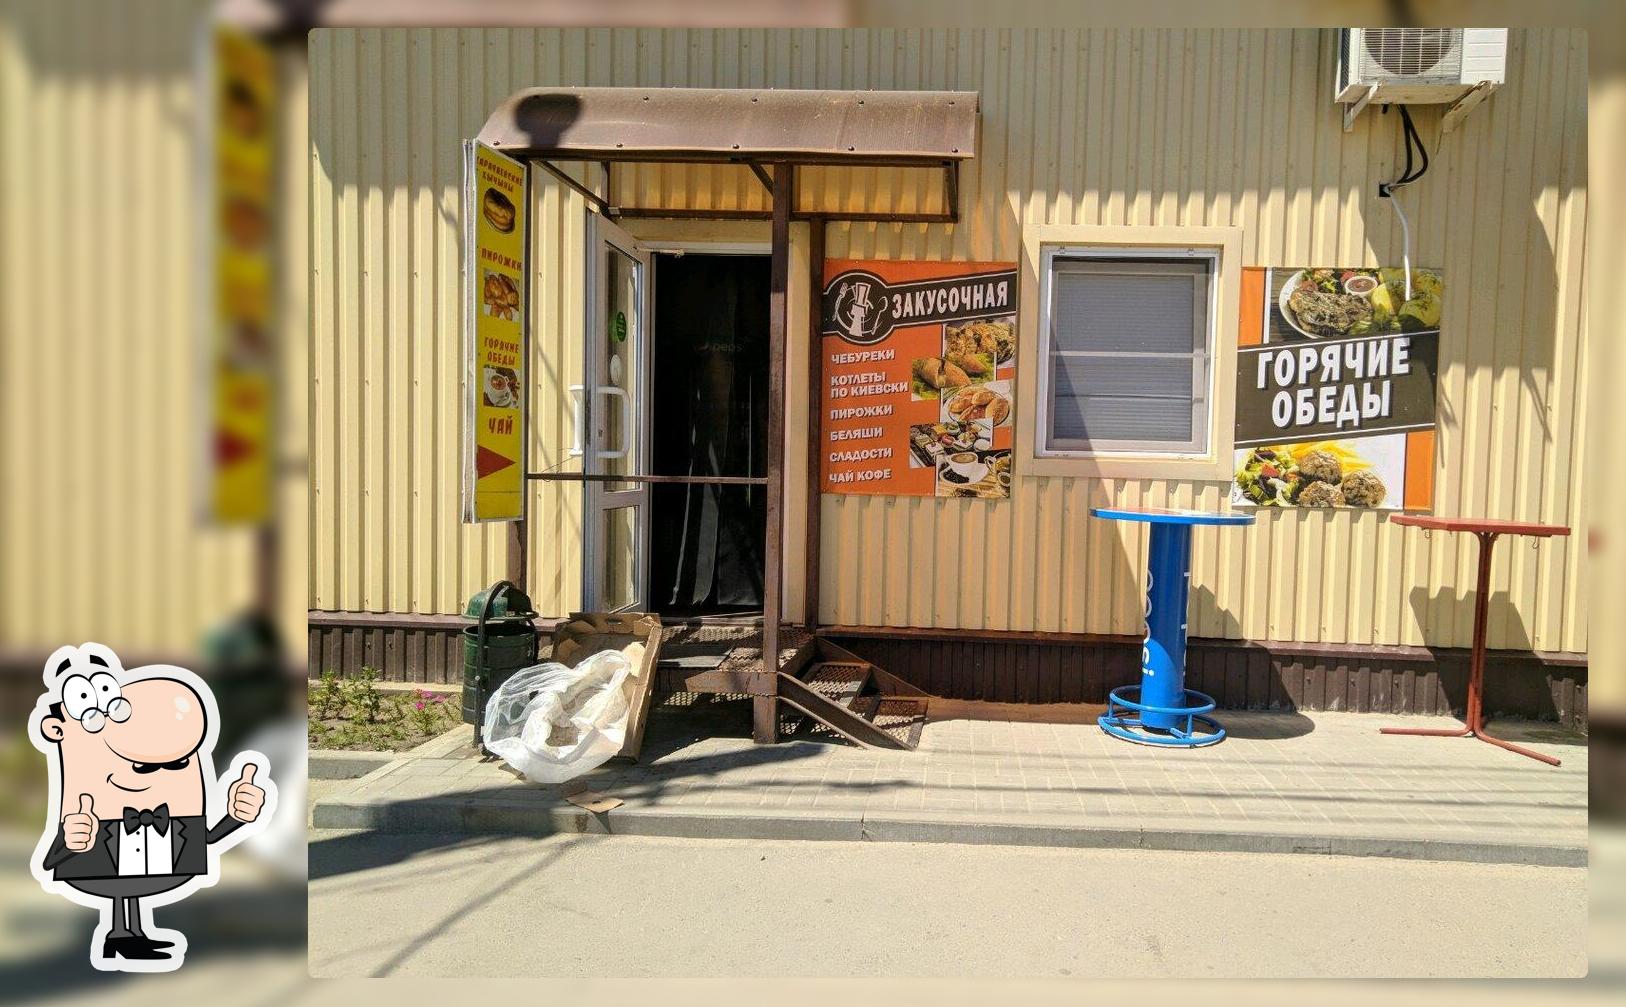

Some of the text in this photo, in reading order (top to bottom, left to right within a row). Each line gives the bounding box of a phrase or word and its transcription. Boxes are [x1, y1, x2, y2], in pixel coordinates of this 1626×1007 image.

[481, 248, 522, 271] ПИРОЖКИ
[892, 281, 1009, 319] ЗАКУСОЧНАЯ
[484, 336, 519, 354] ГОРЯЧИЕ
[487, 352, 515, 366] ОБЕДЫ
[831, 349, 895, 364] ЧЕБУРЕКИ
[1257, 337, 1411, 389] ГОРЯЧИЕ
[831, 372, 886, 386] КОТЛЕТЫ
[831, 382, 909, 399] ПО КИЕВСКИ
[830, 404, 893, 420] ПИРОЖКИ
[1271, 380, 1391, 429] ОБЕДЫ
[488, 415, 514, 435] ЧАЙ
[830, 427, 883, 441] БЕЛЯШИ
[829, 448, 892, 463] СЛАДОСТИ
[829, 470, 892, 484] ЧАЙ КОФЕ
